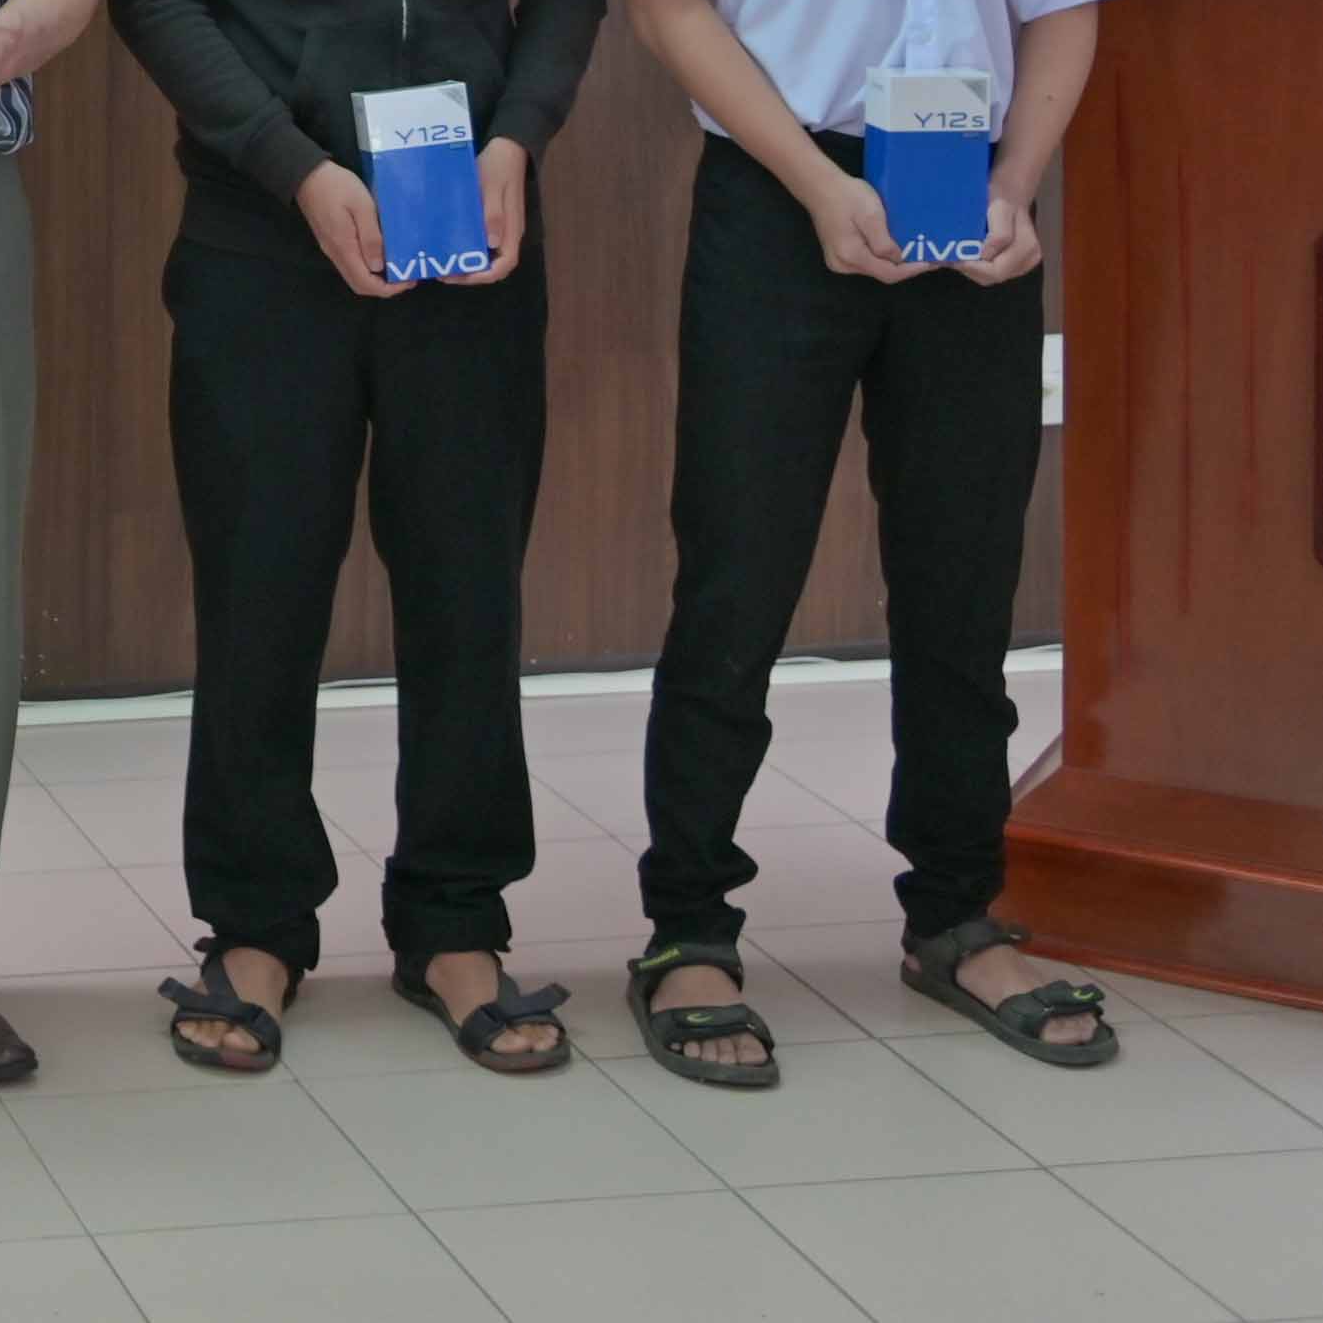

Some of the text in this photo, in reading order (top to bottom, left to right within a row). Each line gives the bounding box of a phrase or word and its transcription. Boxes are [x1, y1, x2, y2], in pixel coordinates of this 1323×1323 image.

[914, 111, 985, 128] Y12s
[395, 124, 467, 144] Y12s
[386, 250, 489, 281] vivo
